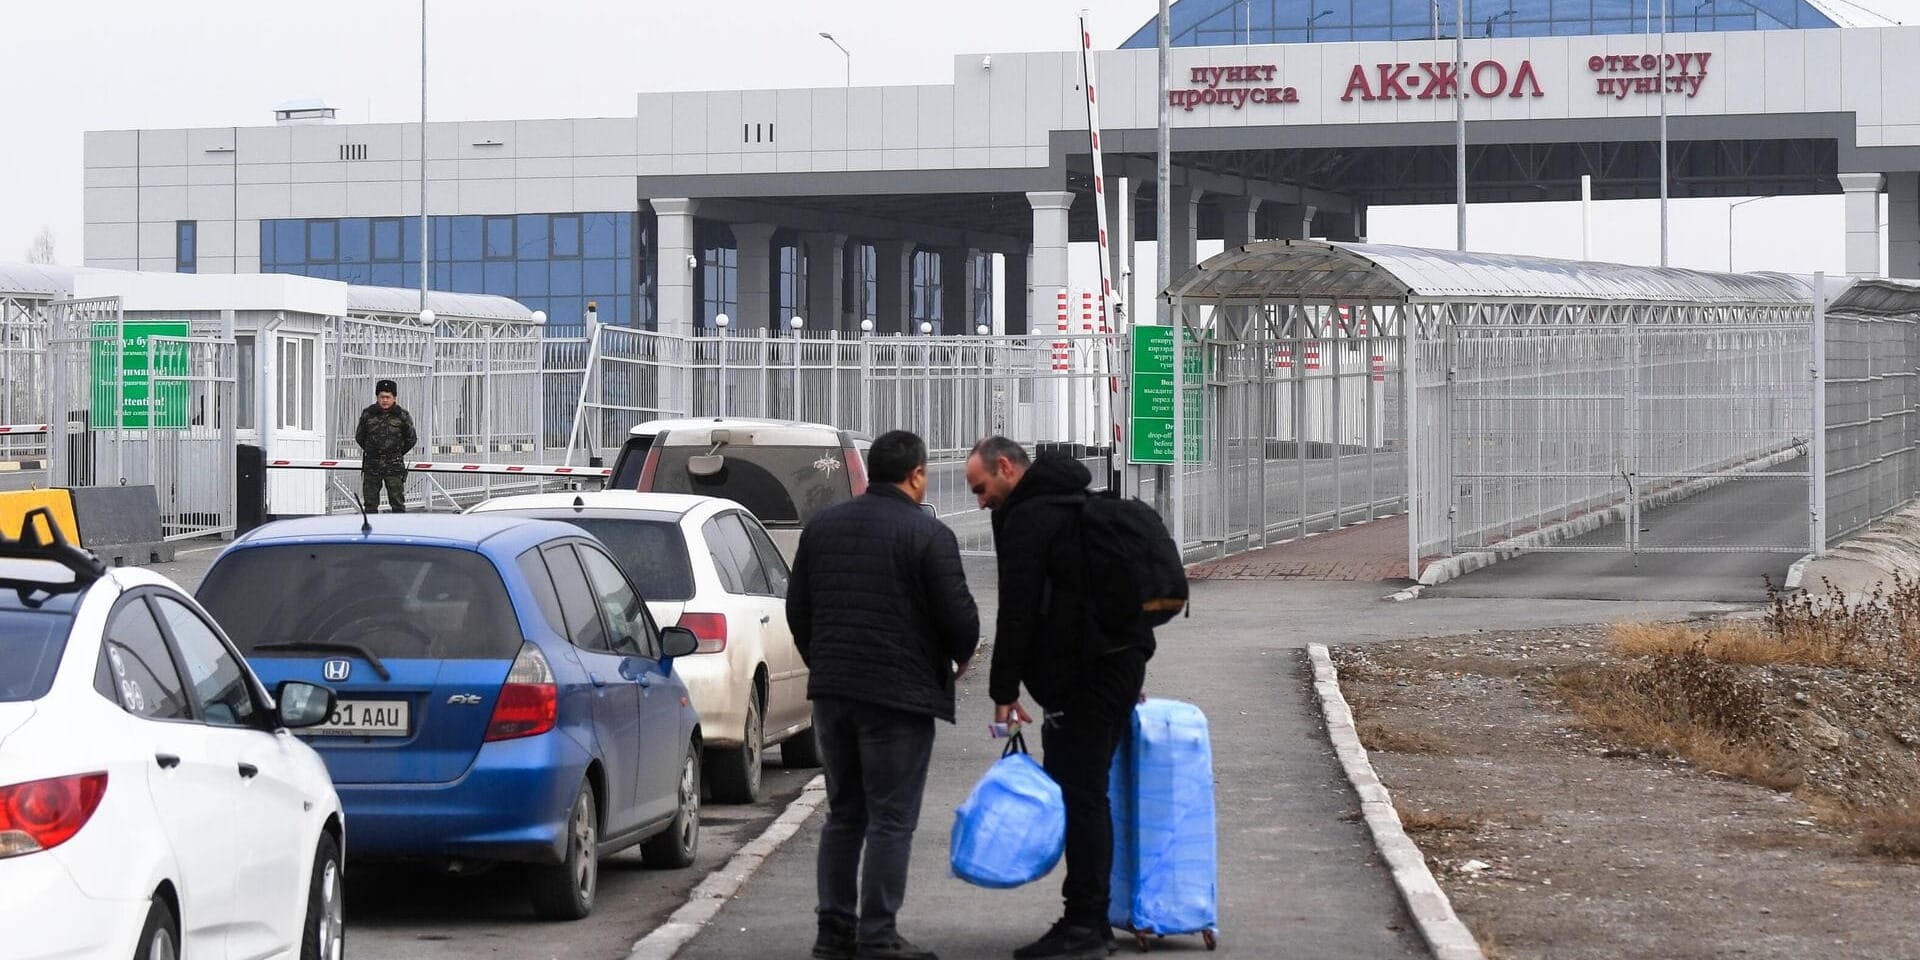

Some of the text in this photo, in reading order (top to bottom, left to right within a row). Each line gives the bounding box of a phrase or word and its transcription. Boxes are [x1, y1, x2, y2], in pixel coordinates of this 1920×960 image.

[1190, 65, 1277, 88] пункт
[1341, 60, 1544, 101] АК-ЖОЛ
[1596, 75, 1705, 100] пункту
[1169, 87, 1299, 112] пропуска
[119, 396, 165, 406] ttentin!
[326, 704, 399, 727] 61 AAU
